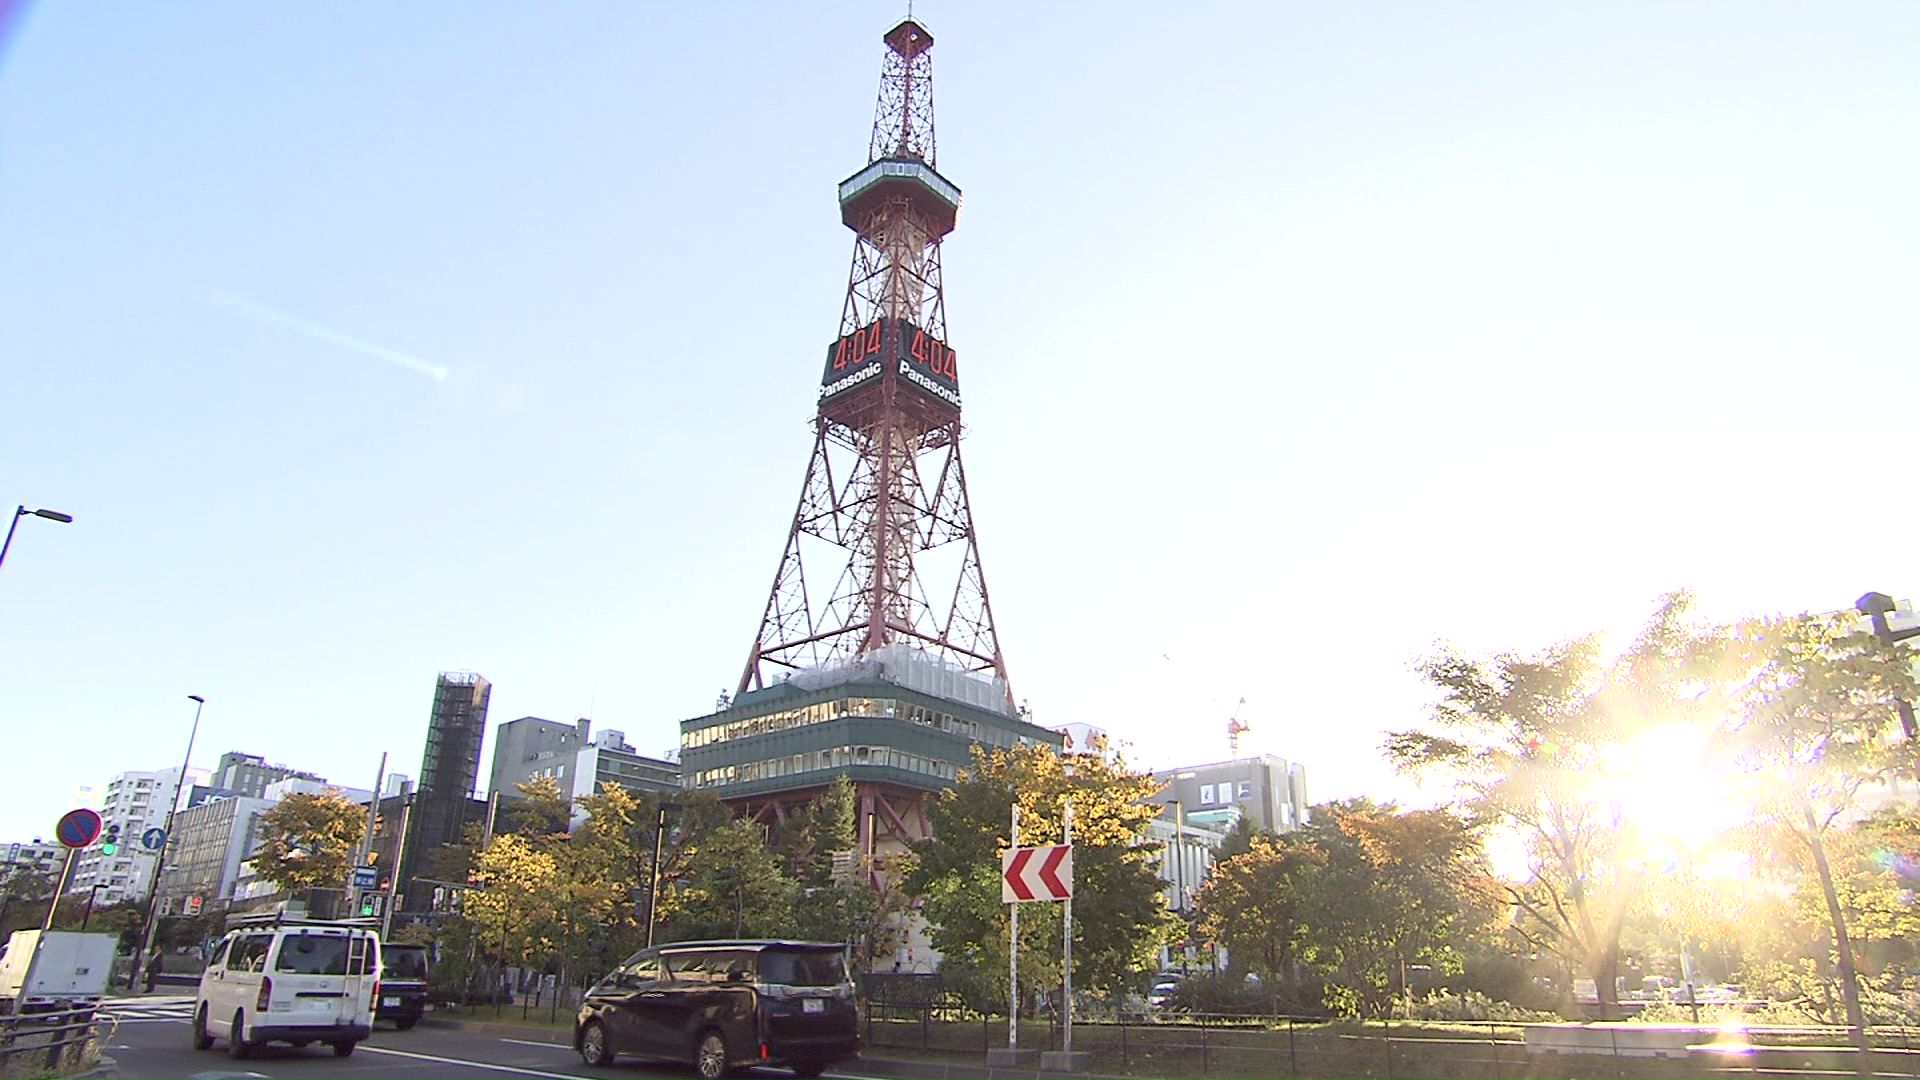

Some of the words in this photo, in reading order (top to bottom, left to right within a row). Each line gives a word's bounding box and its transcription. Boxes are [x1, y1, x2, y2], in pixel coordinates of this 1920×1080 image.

[833, 320, 881, 370] 4:04
[911, 330, 957, 384] 4:04
[817, 361, 882, 400] Panasonic
[899, 360, 962, 407] Panasonic
